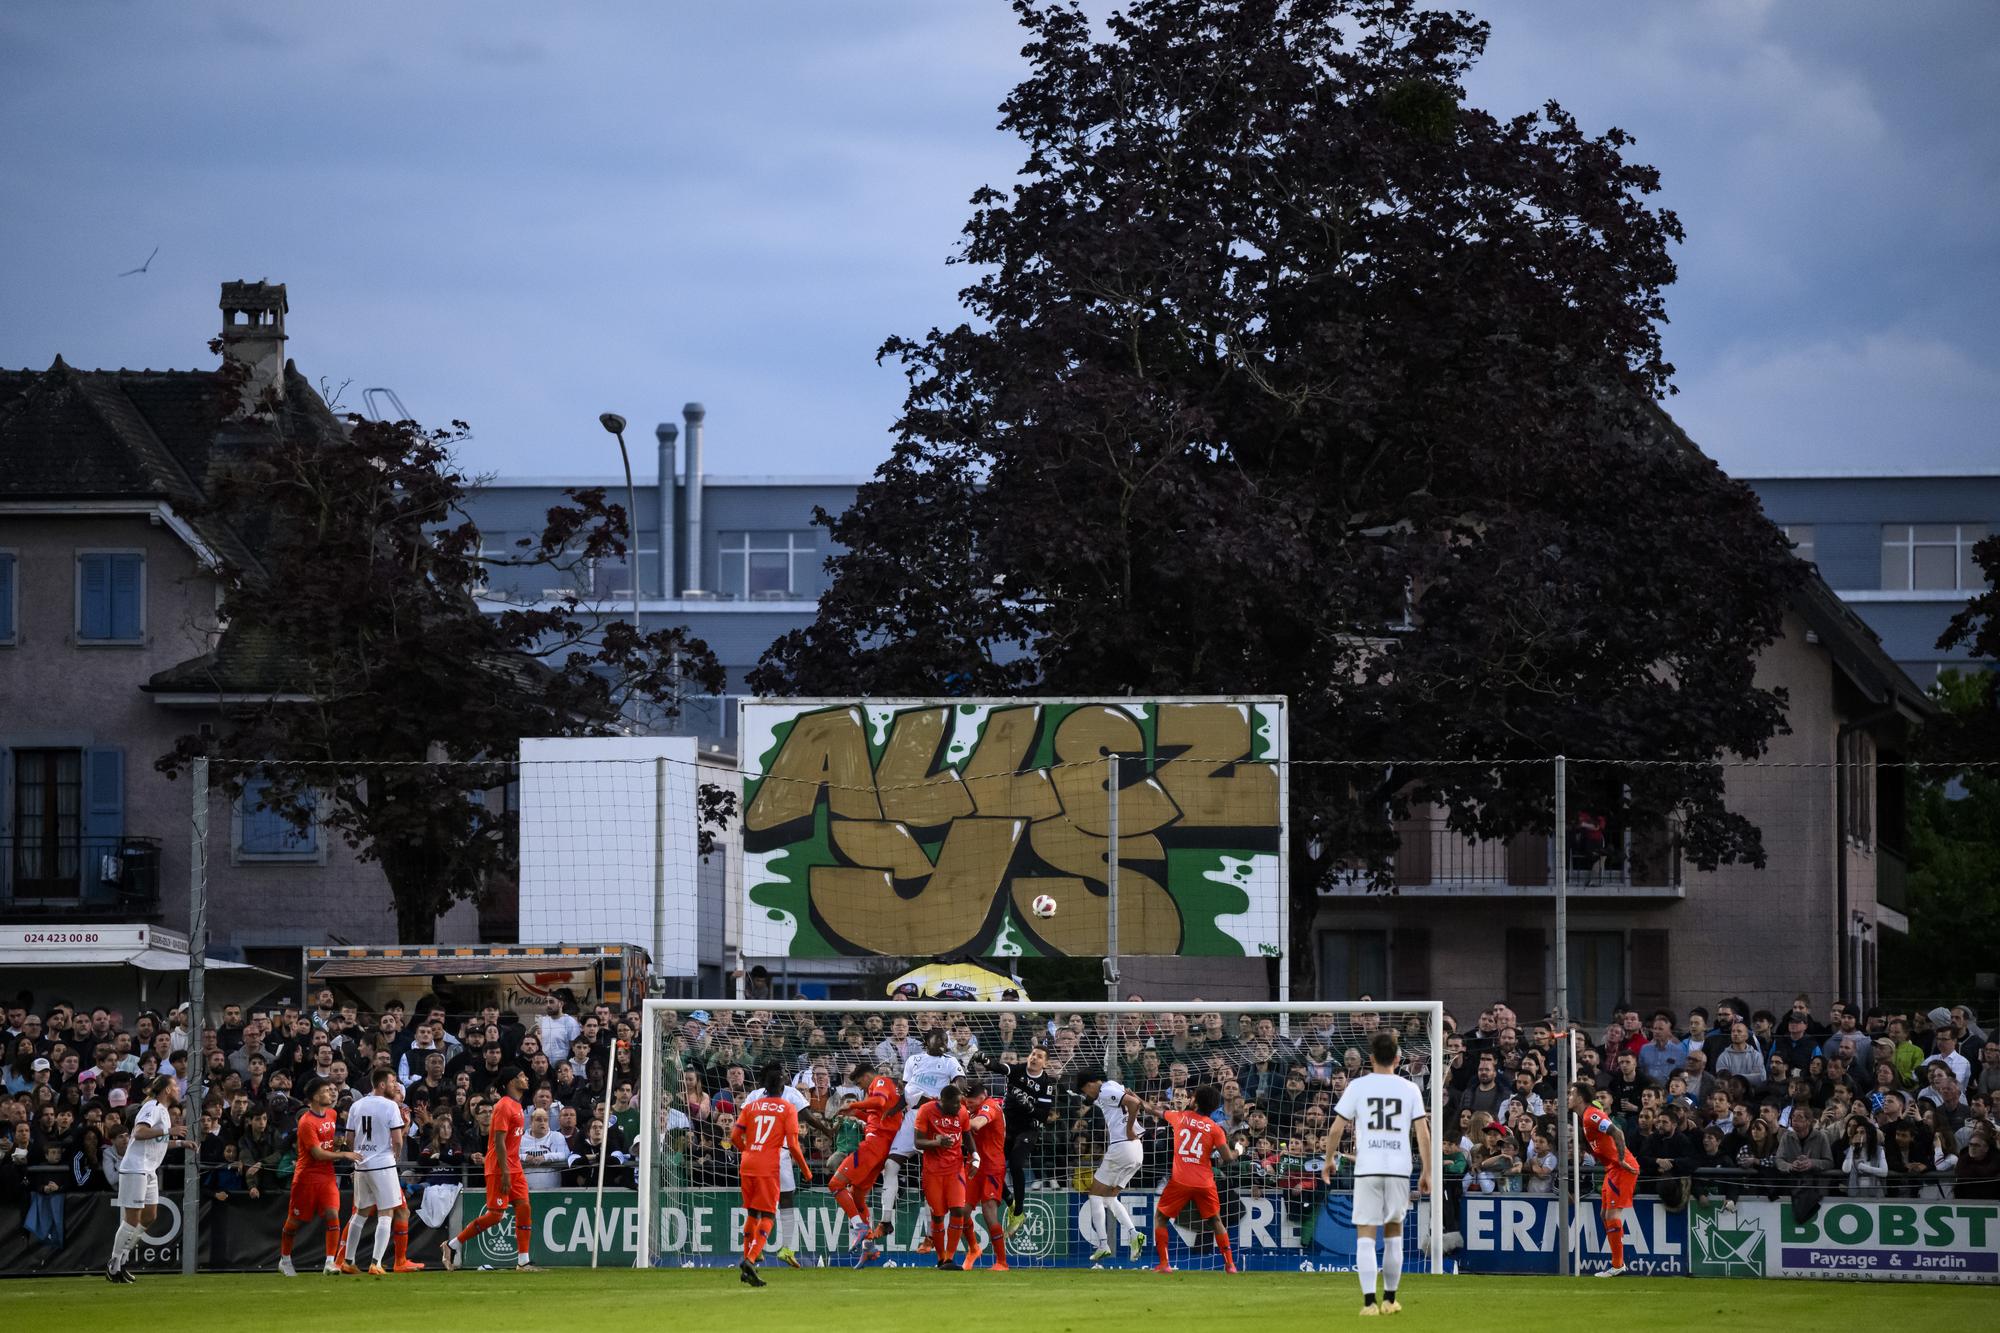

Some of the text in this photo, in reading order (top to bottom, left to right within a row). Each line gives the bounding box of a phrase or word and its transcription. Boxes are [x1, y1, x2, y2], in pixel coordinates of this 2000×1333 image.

[24, 934, 99, 943] 024 423 00 80
[954, 983, 977, 992] Cream
[751, 1101, 785, 1113] INEOS
[1367, 1097, 1402, 1131] 32
[362, 1115, 372, 1141] 4
[754, 1115, 776, 1144] 17
[1179, 1115, 1212, 1133] INEOS
[1178, 1128, 1203, 1158] 24
[1368, 1139, 1401, 1150] SAUTHIER
[543, 1206, 990, 1253] CAVE DE BONVLLAS
[1403, 1199, 1682, 1255] ERMAL
[1780, 1203, 1998, 1248] BOBST
[124, 1244, 180, 1262] ieci
[1810, 1252, 1967, 1269] Paysage & Jardin
